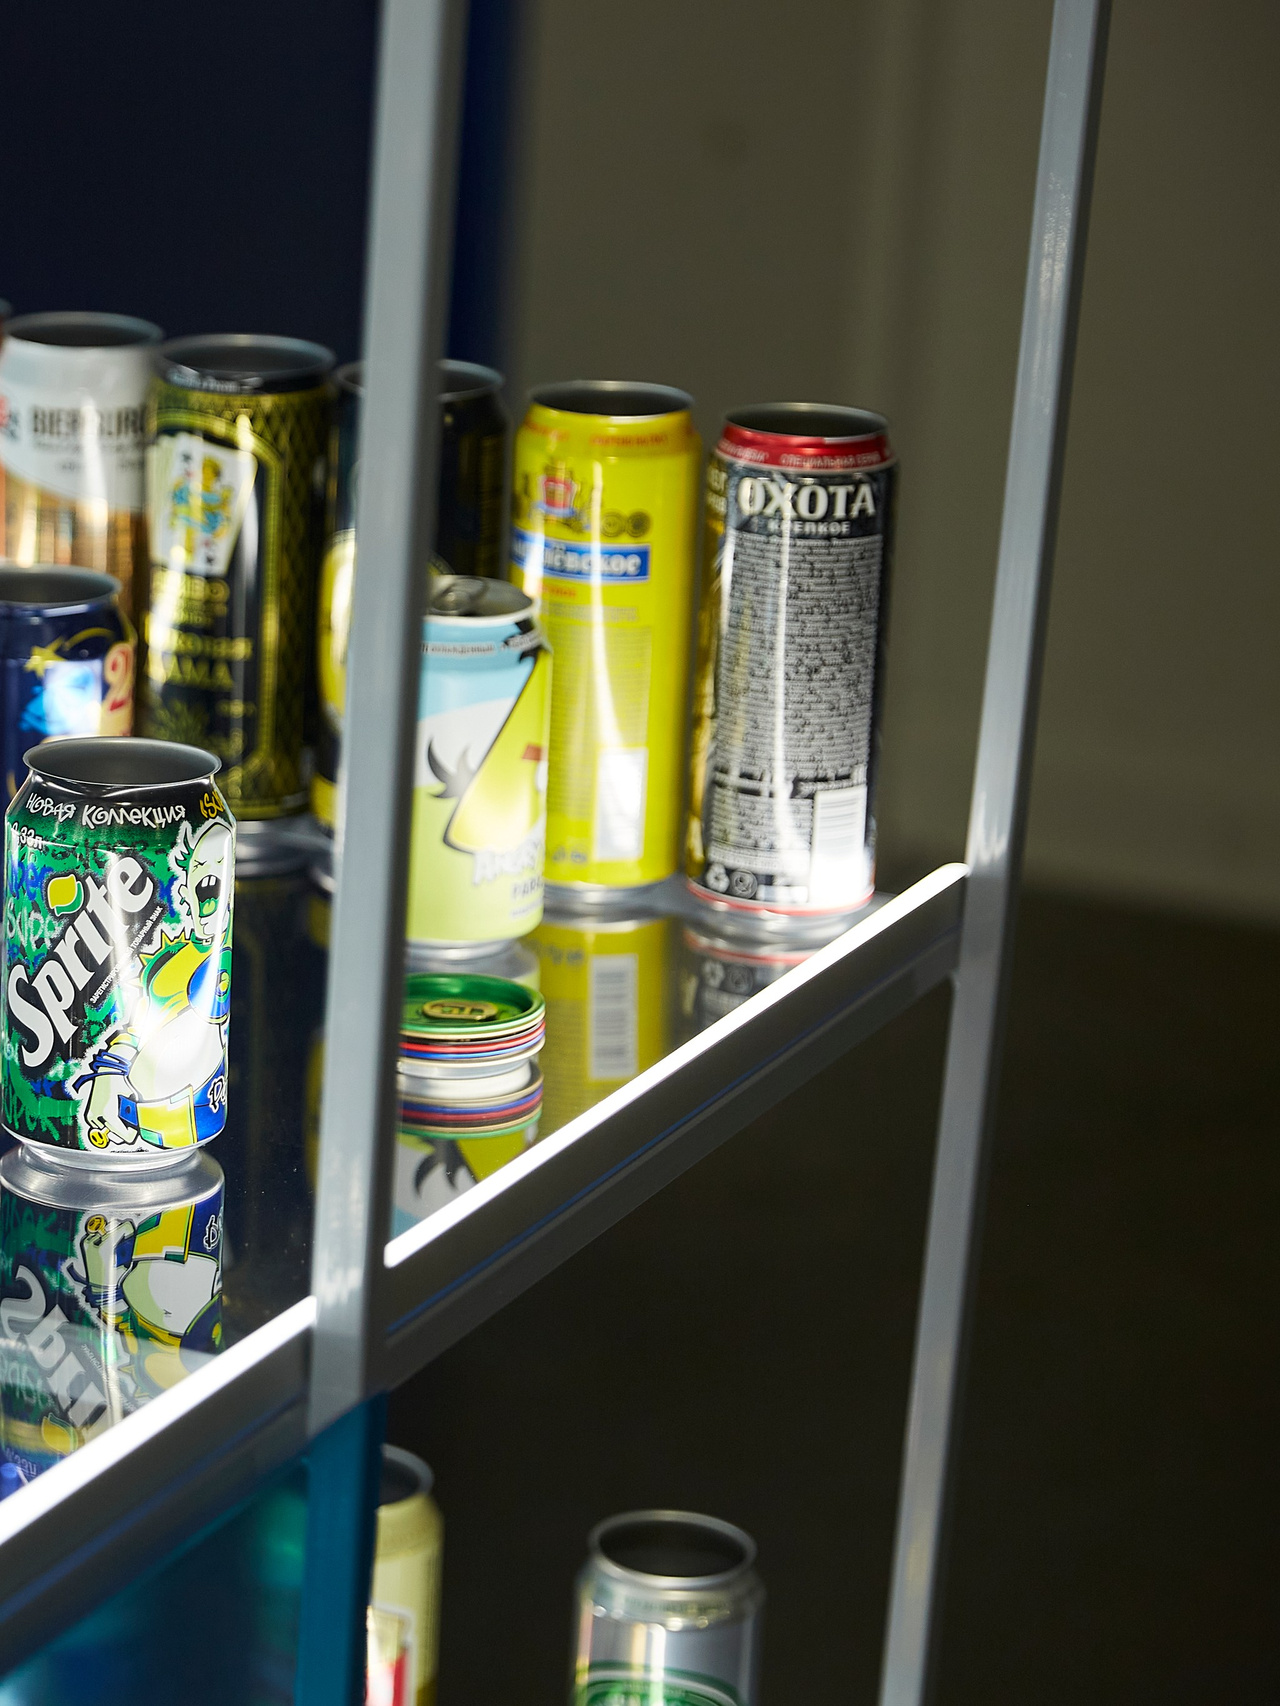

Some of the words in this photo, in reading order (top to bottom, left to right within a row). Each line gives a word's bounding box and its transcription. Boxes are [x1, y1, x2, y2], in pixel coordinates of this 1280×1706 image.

[737, 476, 877, 521] ОХОТА
[768, 517, 852, 536] КЕПКОЕ
[25, 792, 77, 823] НОВАЯ
[7, 856, 154, 1068] Sprite
